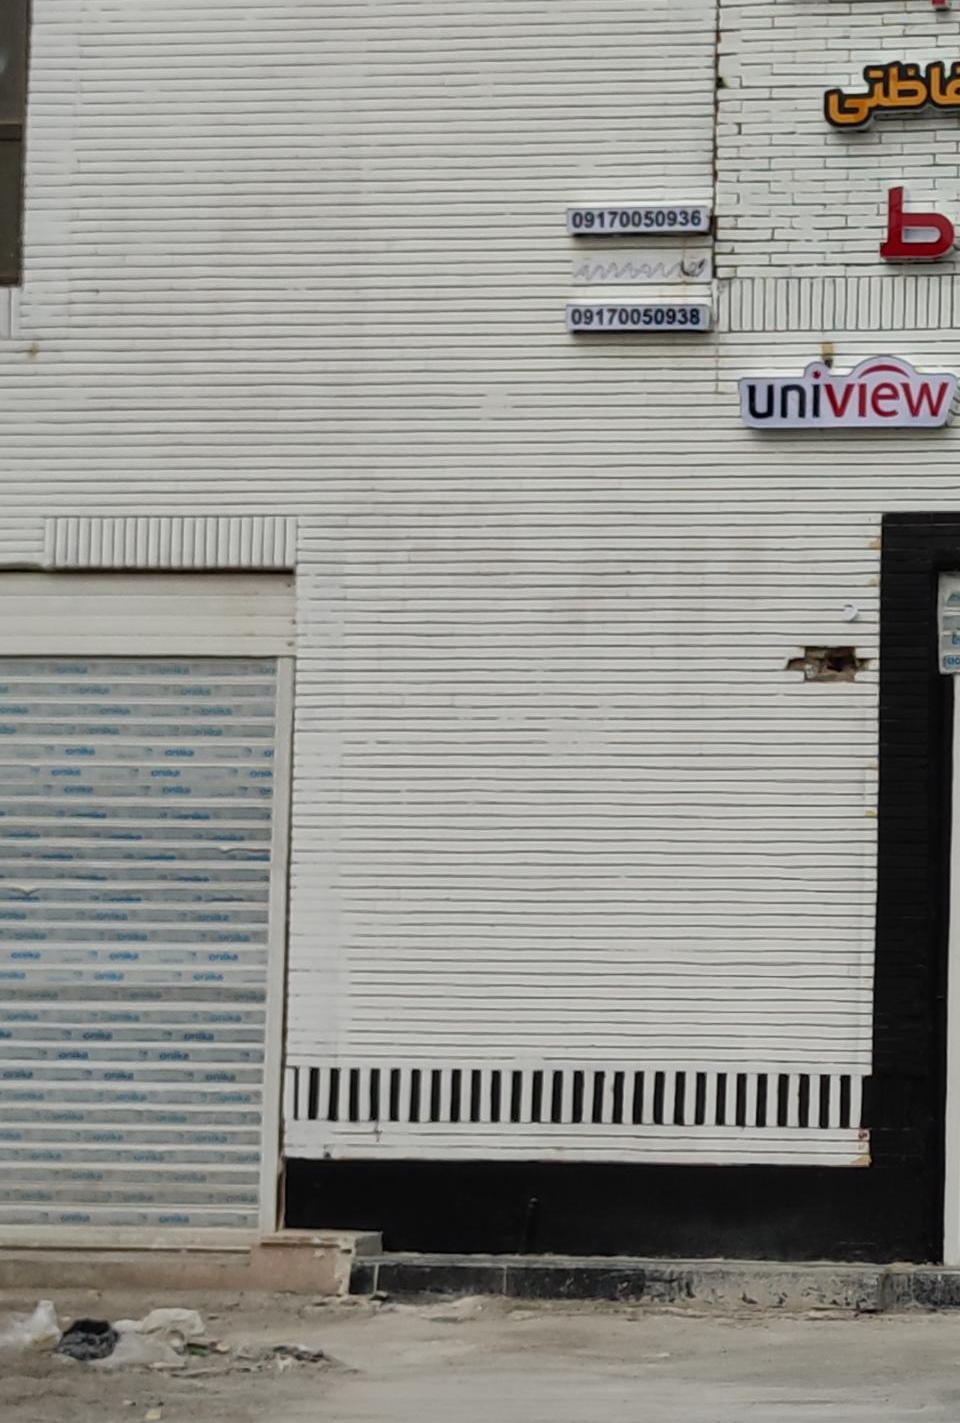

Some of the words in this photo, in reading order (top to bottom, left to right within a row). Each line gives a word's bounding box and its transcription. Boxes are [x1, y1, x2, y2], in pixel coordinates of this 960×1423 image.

[571, 209, 702, 229] 09170050936
[570, 307, 701, 326] 09170050938
[747, 366, 950, 419] uniview
